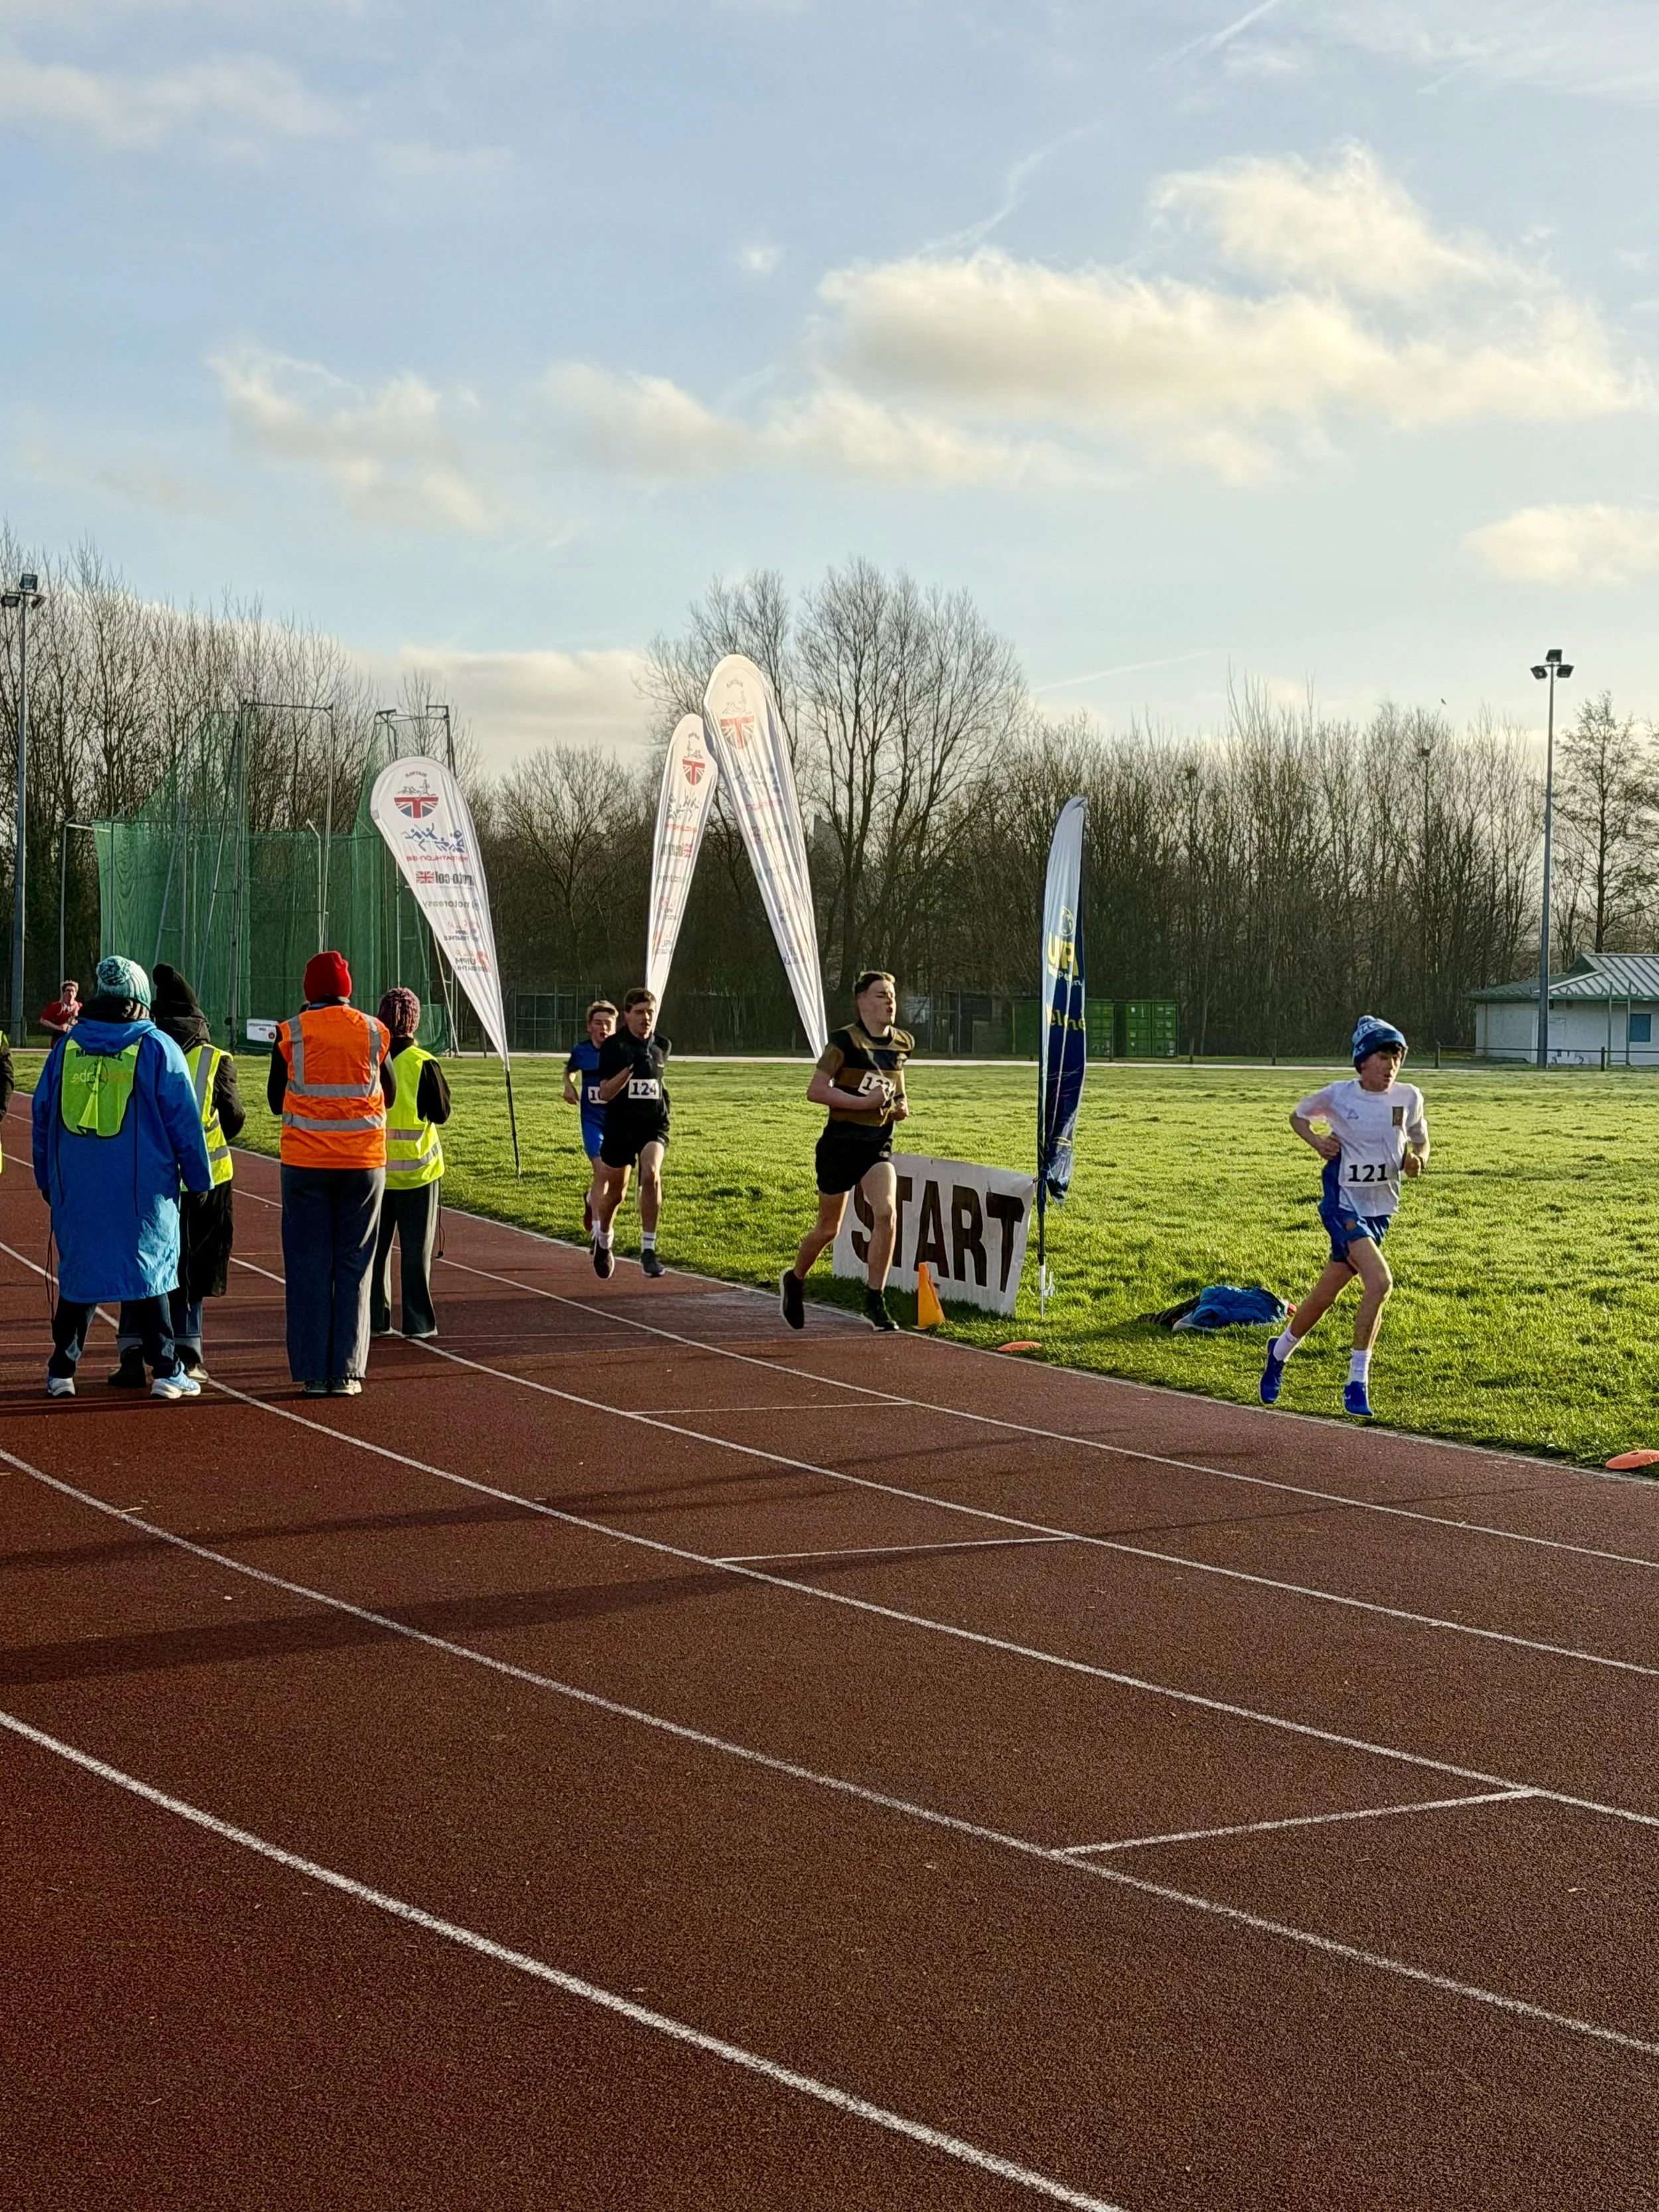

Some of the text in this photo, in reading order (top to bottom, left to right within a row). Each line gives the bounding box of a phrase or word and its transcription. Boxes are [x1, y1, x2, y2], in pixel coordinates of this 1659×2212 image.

[630, 1082, 657, 1096] 124
[1348, 1163, 1388, 1183] 121
[851, 1175, 1025, 1293] START
